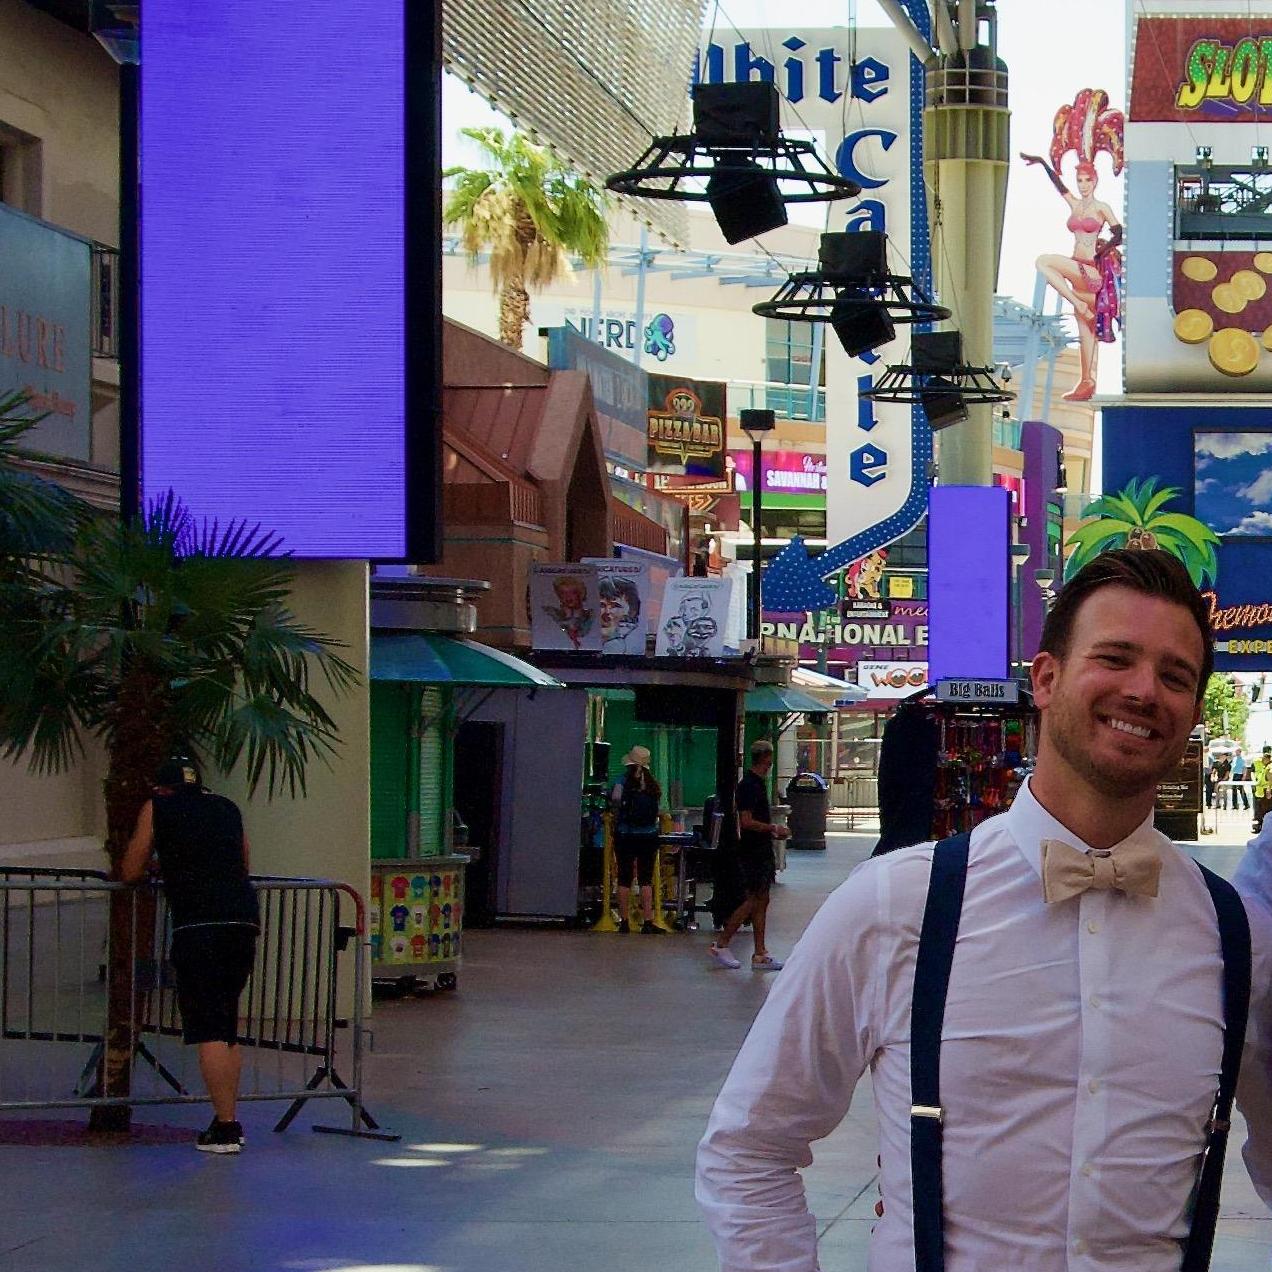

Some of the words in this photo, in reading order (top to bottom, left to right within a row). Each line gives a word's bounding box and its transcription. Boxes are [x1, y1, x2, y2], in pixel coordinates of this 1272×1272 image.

[836, 129, 897, 487] Cale
[1, 304, 64, 373] LURE
[761, 622, 910, 645] RNAIONAL
[949, 682, 971, 699] Big
[974, 683, 1005, 698] Balls
